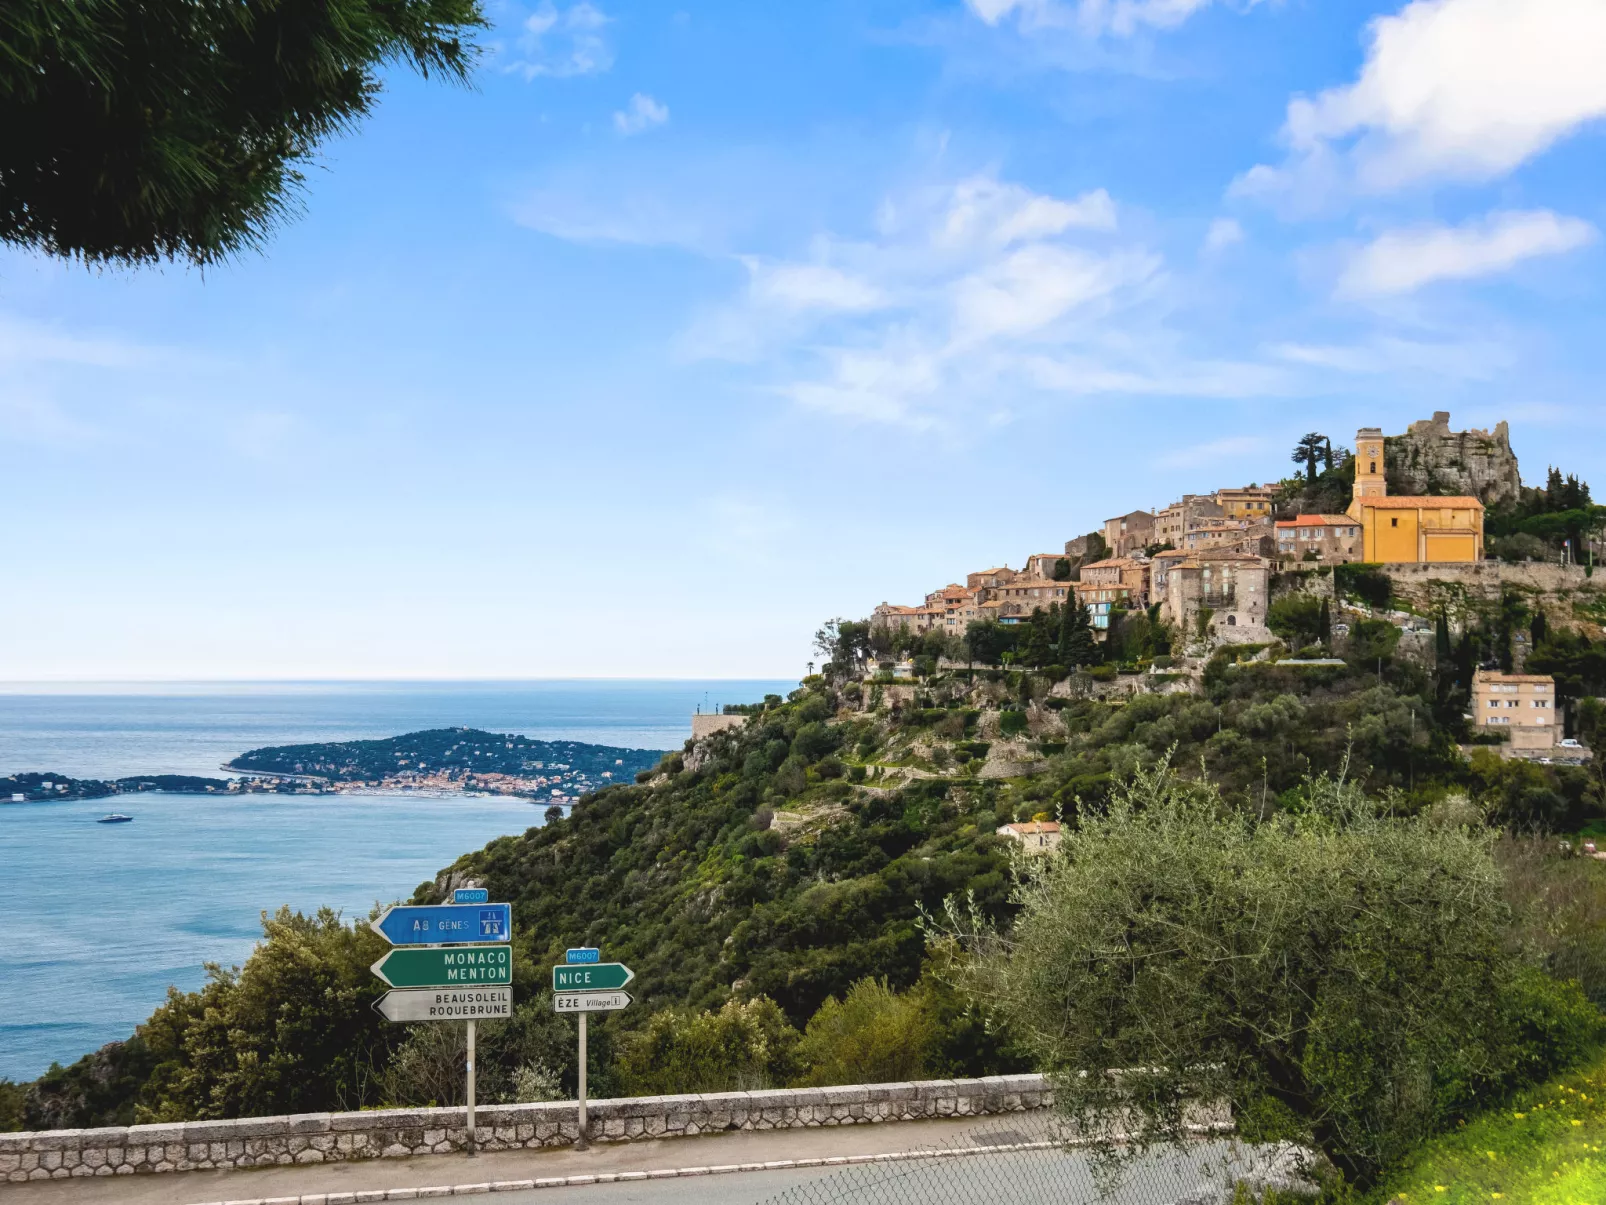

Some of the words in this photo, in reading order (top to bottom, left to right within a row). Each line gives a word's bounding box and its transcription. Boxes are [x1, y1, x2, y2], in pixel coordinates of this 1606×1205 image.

[413, 920, 430, 931] A8
[444, 952, 506, 965] MONACO
[569, 952, 597, 960] M6007
[448, 967, 506, 980] MENTON
[559, 972, 591, 984] NICE
[436, 992, 507, 1003] BEAUSOLEIL
[586, 999, 611, 1008] Village
[430, 1005, 507, 1016] ROQUEBRUNE
